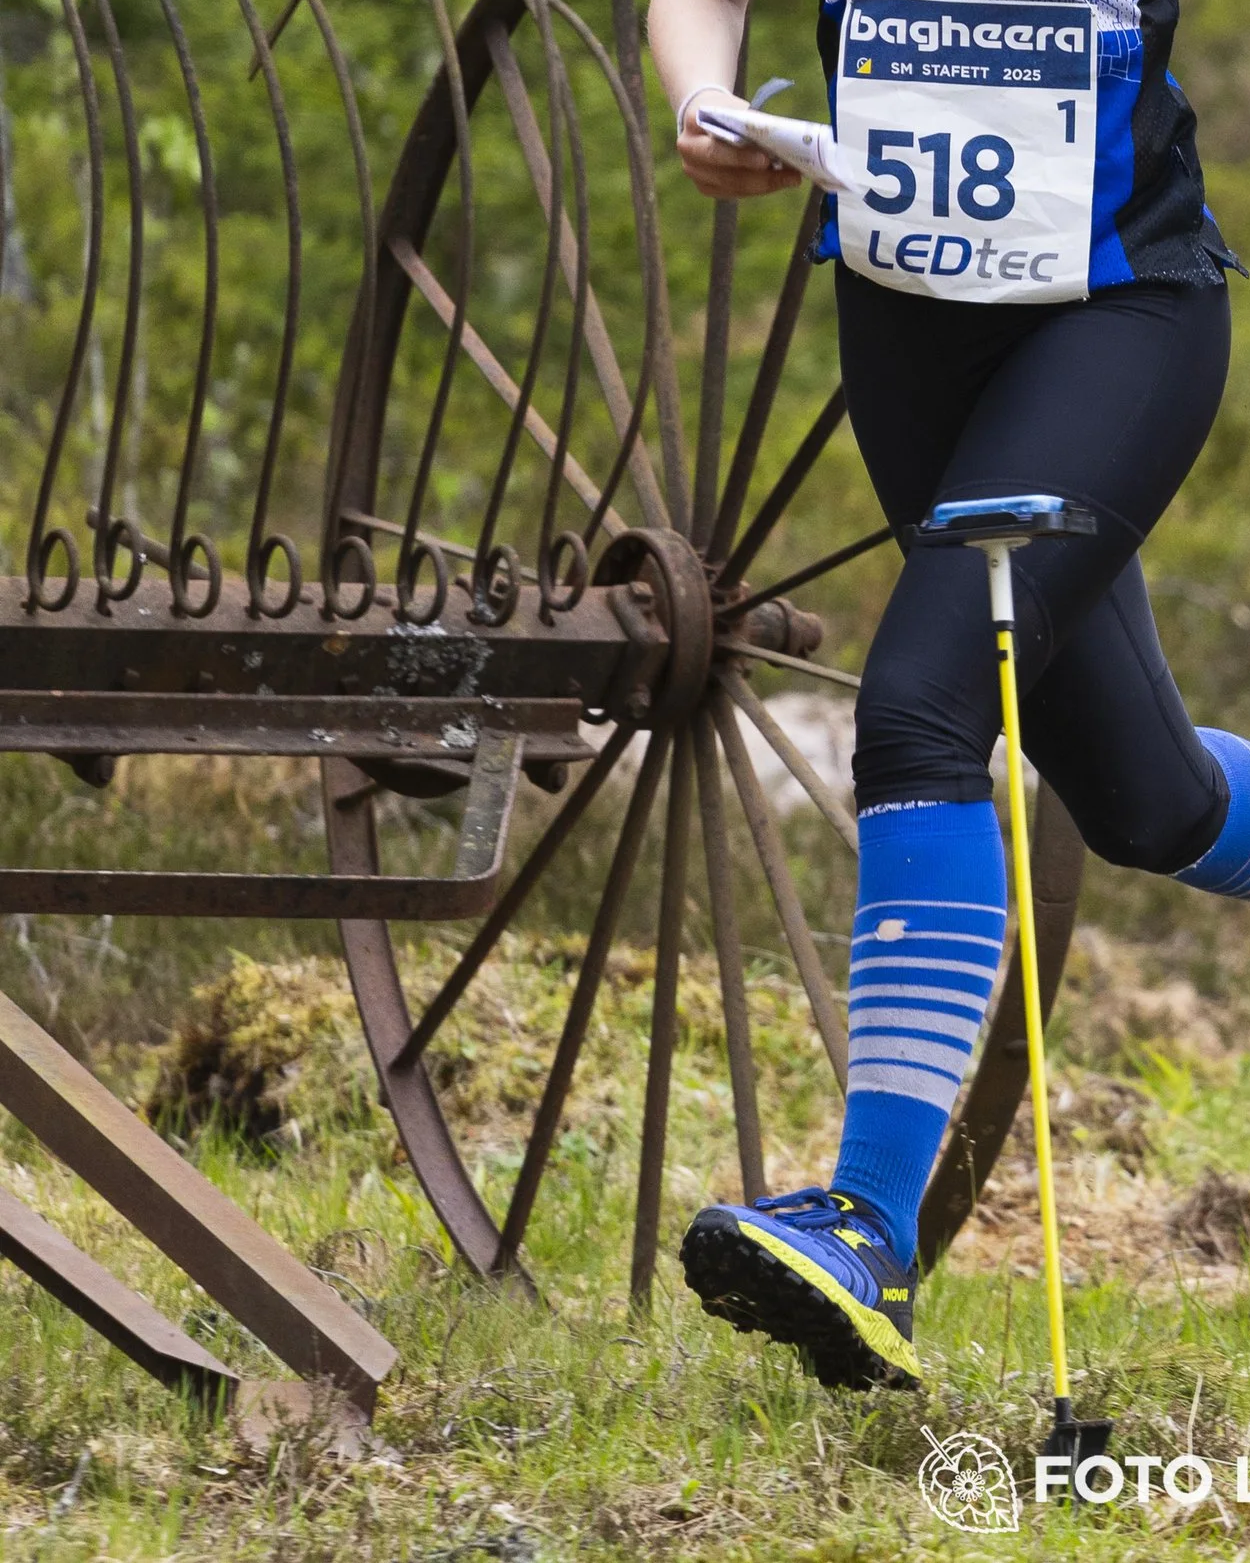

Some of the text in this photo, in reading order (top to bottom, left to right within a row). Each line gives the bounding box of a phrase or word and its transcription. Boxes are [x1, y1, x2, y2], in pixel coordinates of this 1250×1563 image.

[849, 9, 1085, 54] bagheera
[890, 62, 1042, 82] SM STAFETT 2025
[1056, 99, 1076, 144] 1
[863, 128, 1016, 221] 518
[868, 230, 1059, 283] LEDtec
